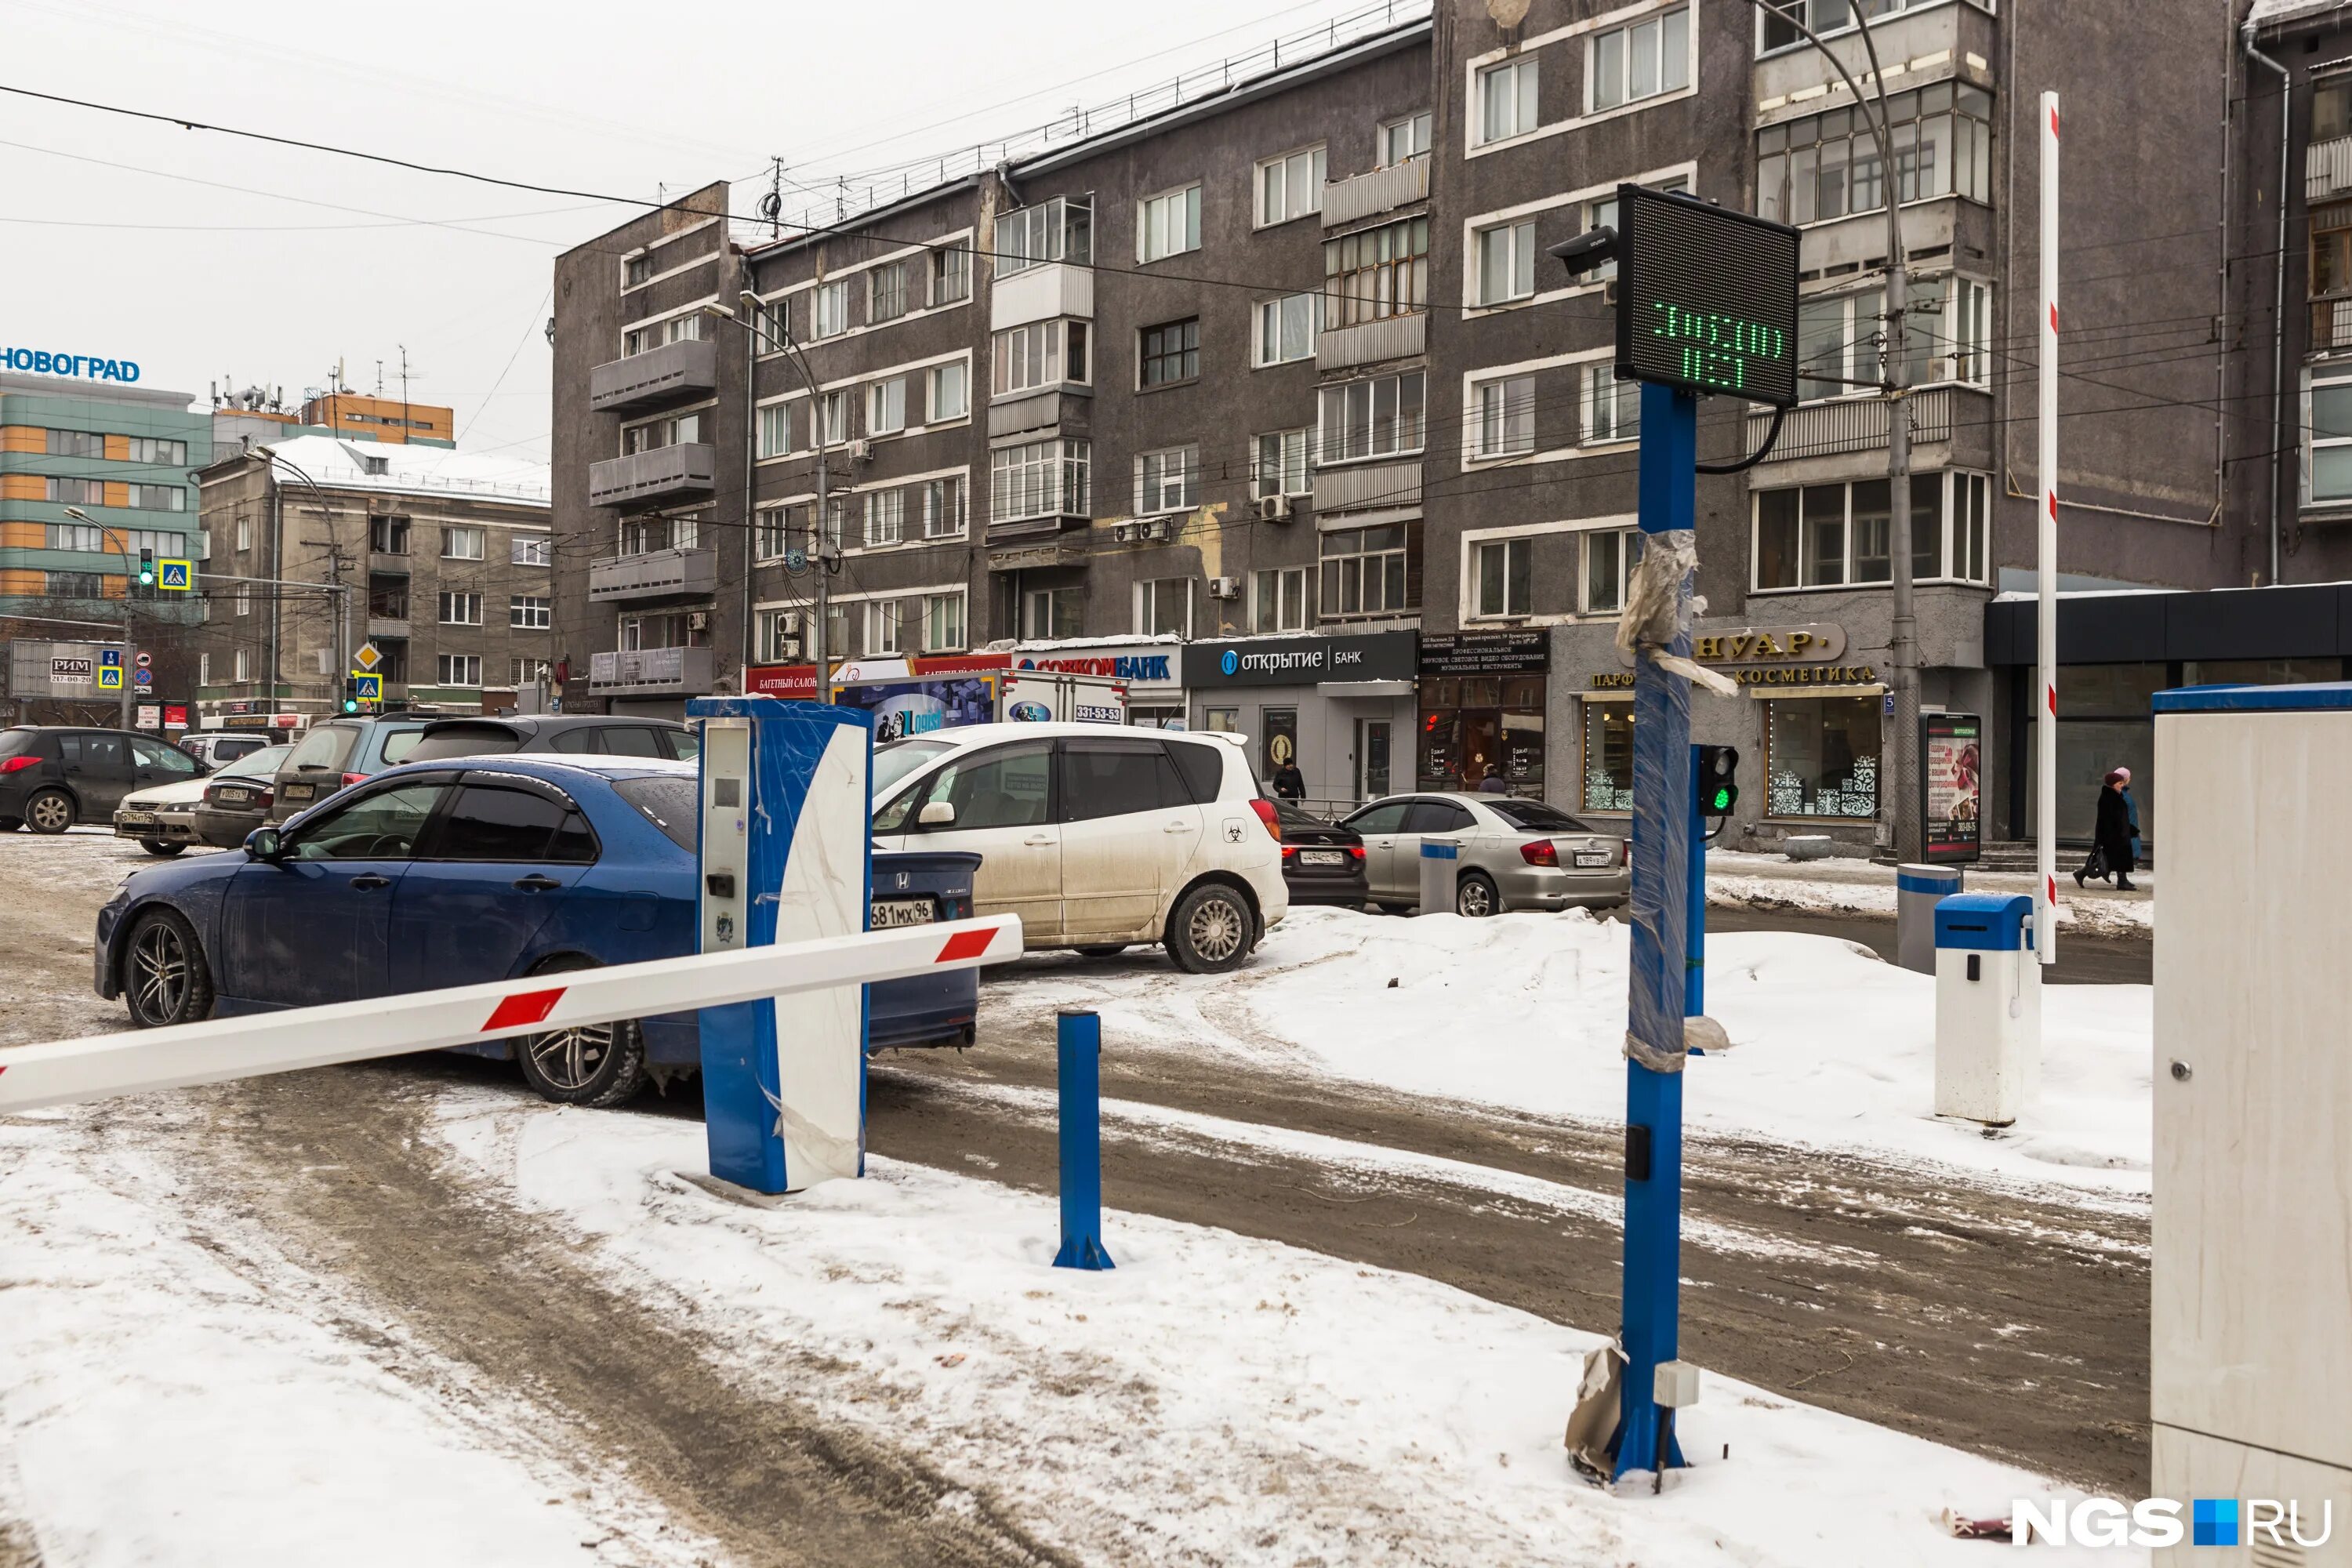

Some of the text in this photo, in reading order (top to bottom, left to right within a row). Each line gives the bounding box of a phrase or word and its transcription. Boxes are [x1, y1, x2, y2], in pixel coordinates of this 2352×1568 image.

[1334, 651, 1363, 664] БАНК
[1501, 653, 1545, 662] ОБОРУДОВАНИЕ
[53, 659, 89, 671] РИМ
[759, 675, 818, 689] БАГЕТНЫЙ САЛОН
[1735, 666, 1875, 684] КОСМЕТИКА
[1076, 706, 1120, 720] 331-53-53
[915, 902, 929, 920] 96
